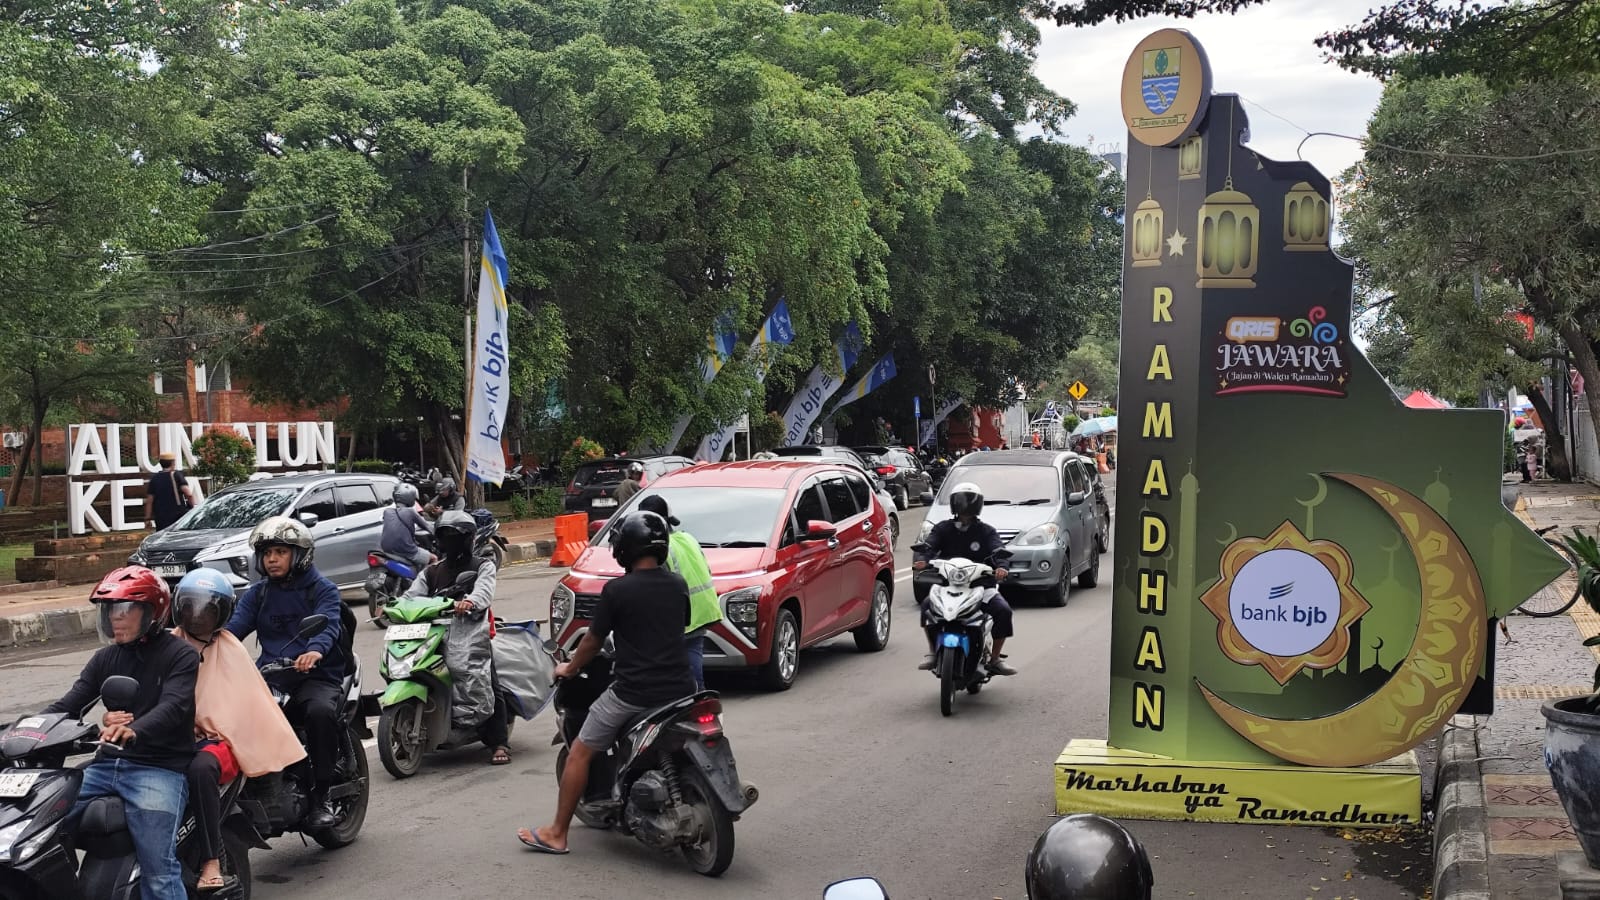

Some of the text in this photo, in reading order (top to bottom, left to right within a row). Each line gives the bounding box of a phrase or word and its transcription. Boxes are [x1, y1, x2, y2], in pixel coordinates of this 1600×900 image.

[1230, 320, 1276, 338] QRIS
[1216, 344, 1343, 372] JAWARA
[1254, 372, 1261, 380] di
[1262, 373, 1289, 382] Waktu
[801, 387, 821, 414] bjb
[1134, 286, 1174, 727] RAMADHAN
[1241, 603, 1327, 627] bank bjb
[1064, 769, 1229, 794] Marhaban
[1184, 793, 1223, 813] ya
[1236, 797, 1412, 825] Ramadhan
